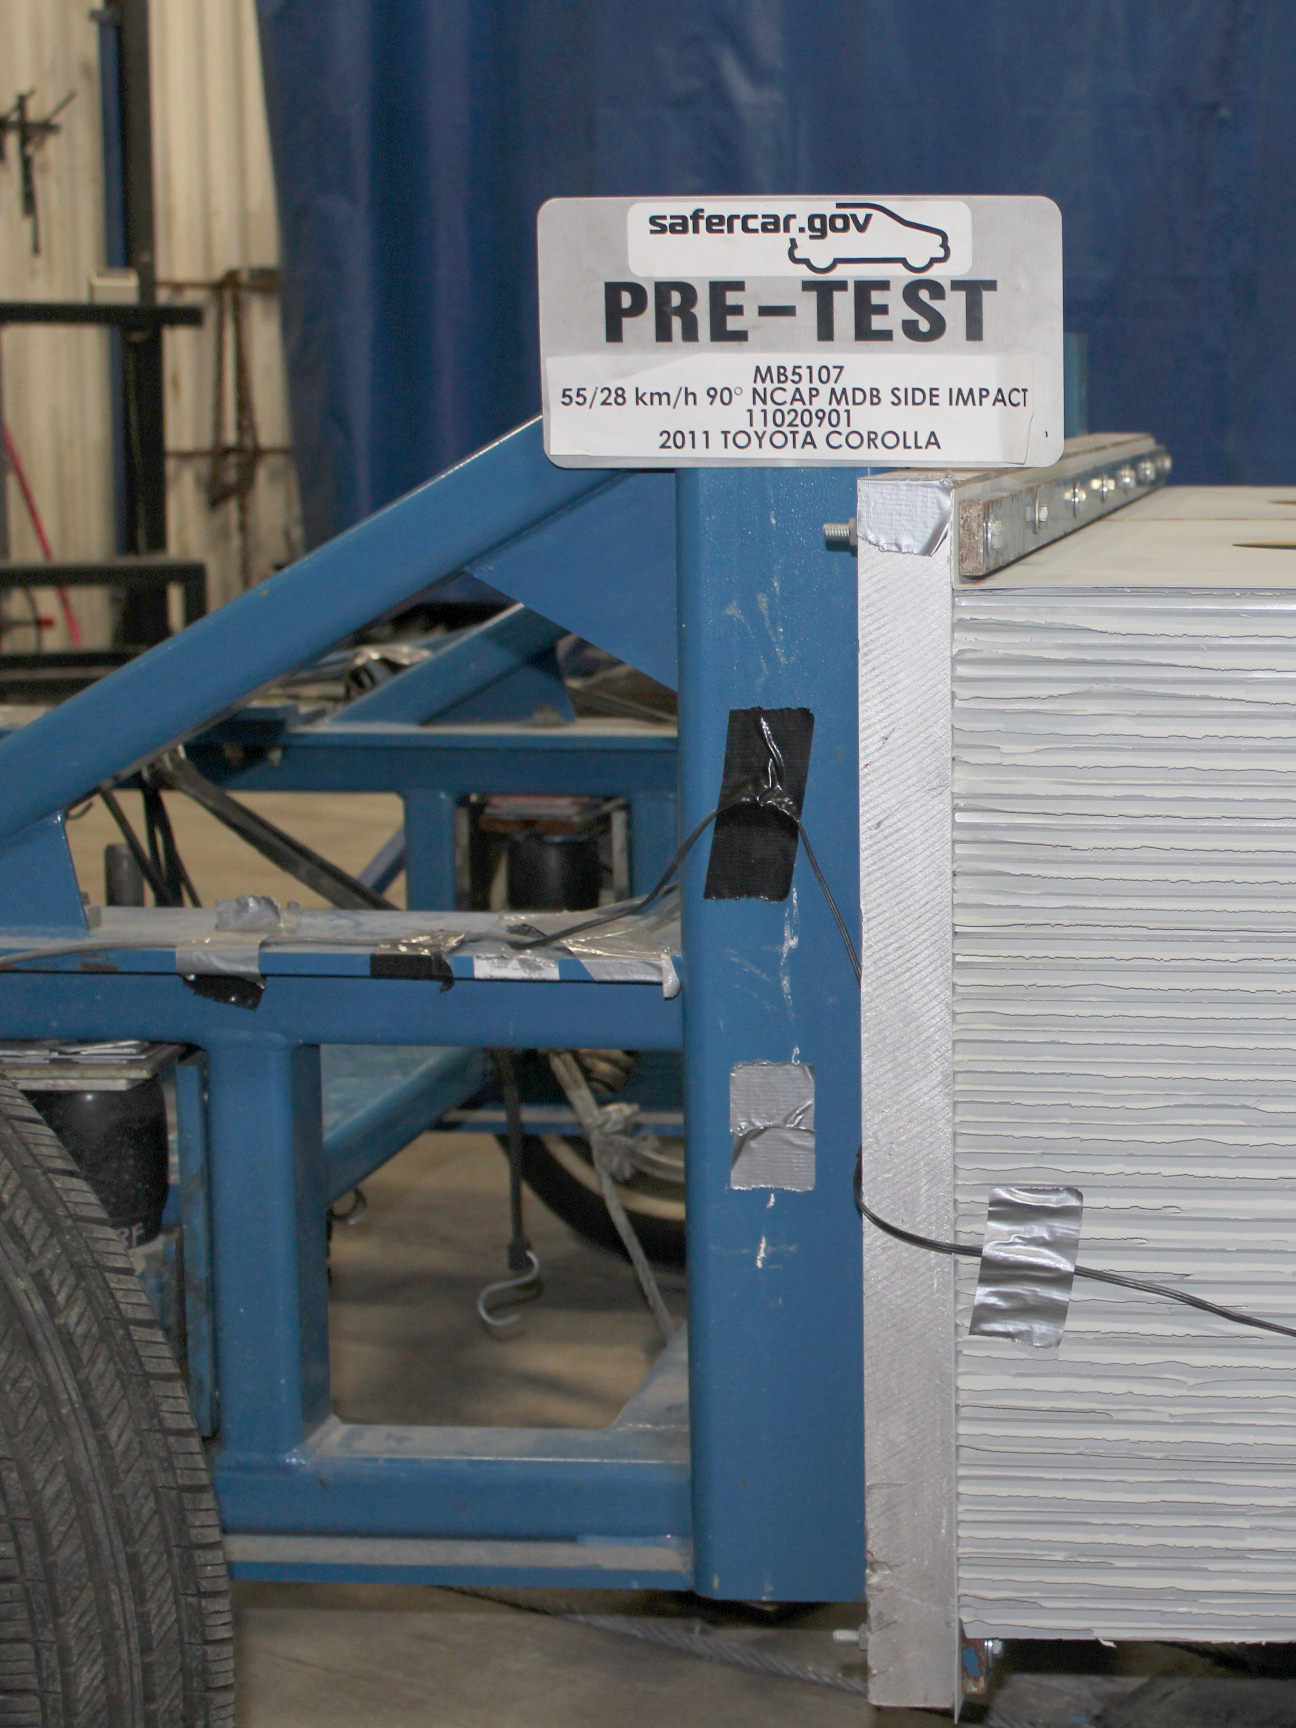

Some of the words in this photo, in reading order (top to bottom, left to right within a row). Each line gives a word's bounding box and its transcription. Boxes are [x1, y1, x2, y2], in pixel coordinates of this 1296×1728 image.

[648, 208, 873, 240] safercar.gov
[603, 279, 998, 343] PRE-TEST
[752, 365, 845, 385] MB5107
[560, 386, 627, 409] 55/28
[634, 386, 698, 409] km/h
[705, 386, 744, 406] 90°
[752, 387, 821, 406] NCAP
[828, 387, 882, 406] MDB
[890, 387, 940, 406] SIDE
[948, 387, 1029, 408] IMPACT
[746, 408, 852, 428] 11020901
[658, 430, 710, 449] 2011
[720, 430, 818, 450] TOYOTA
[825, 430, 942, 450] COROLLA
